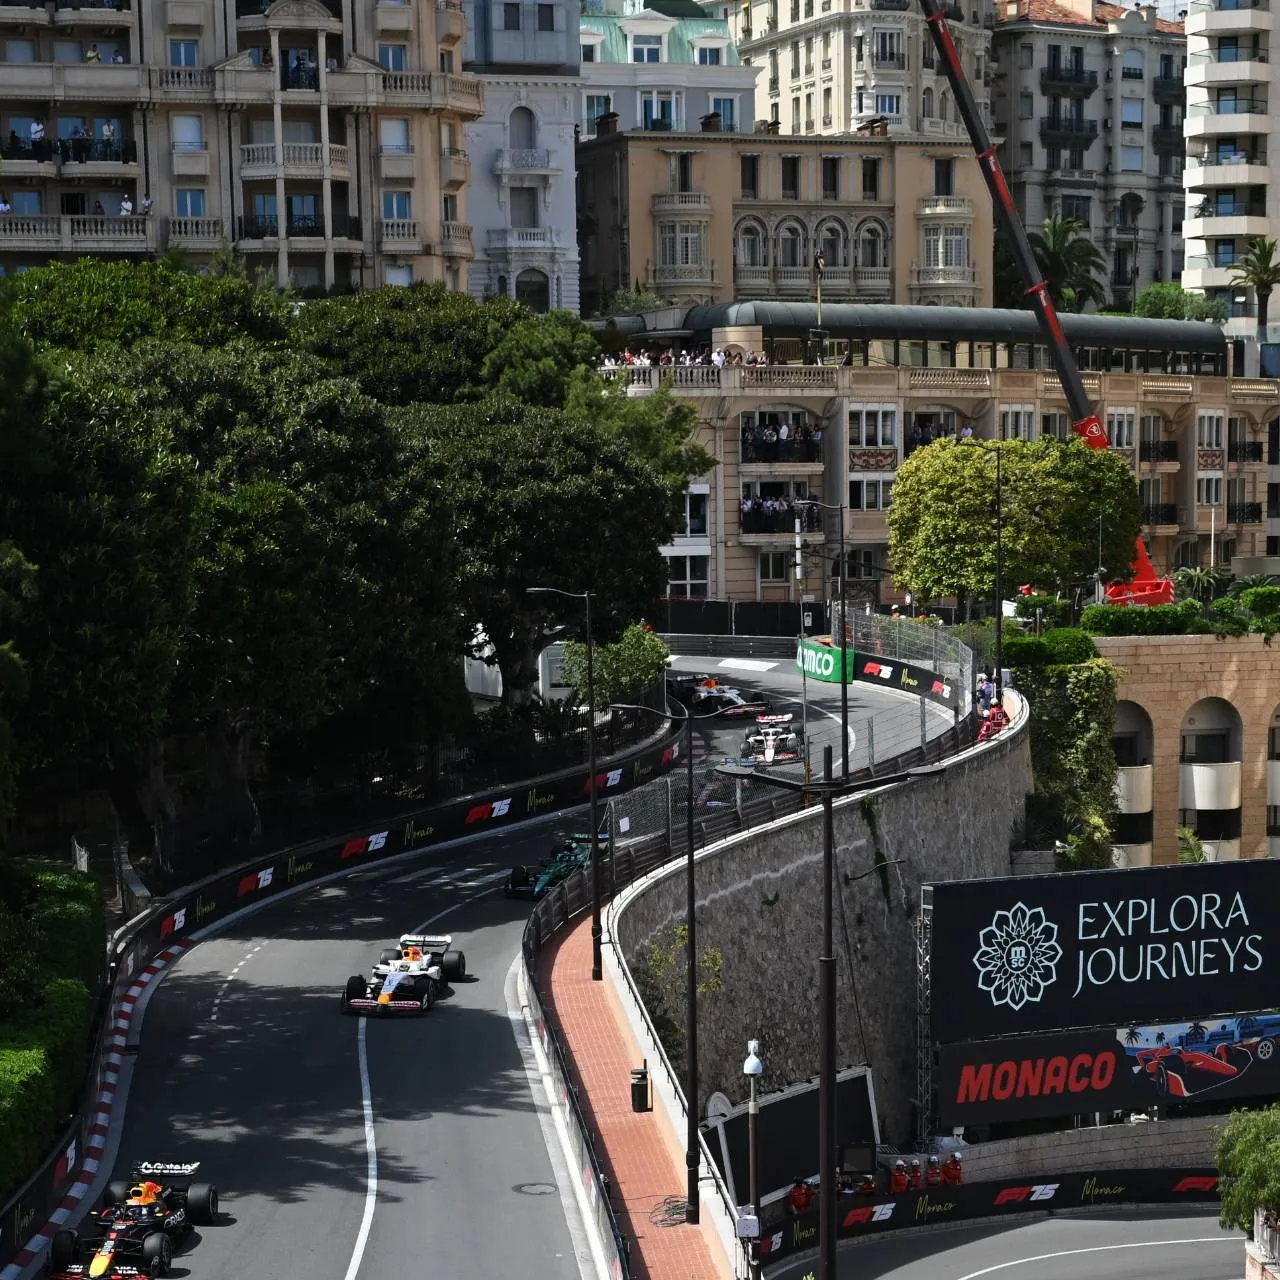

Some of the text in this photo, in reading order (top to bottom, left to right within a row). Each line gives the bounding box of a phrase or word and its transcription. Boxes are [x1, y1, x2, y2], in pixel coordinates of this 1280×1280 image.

[1078, 891, 1250, 941] EXPLORA
[1072, 935, 1263, 998] JOURNEYS
[956, 1051, 1116, 1103] MONACO
[915, 1194, 956, 1226] Monaco
[1081, 1176, 1126, 1205] Monaco
